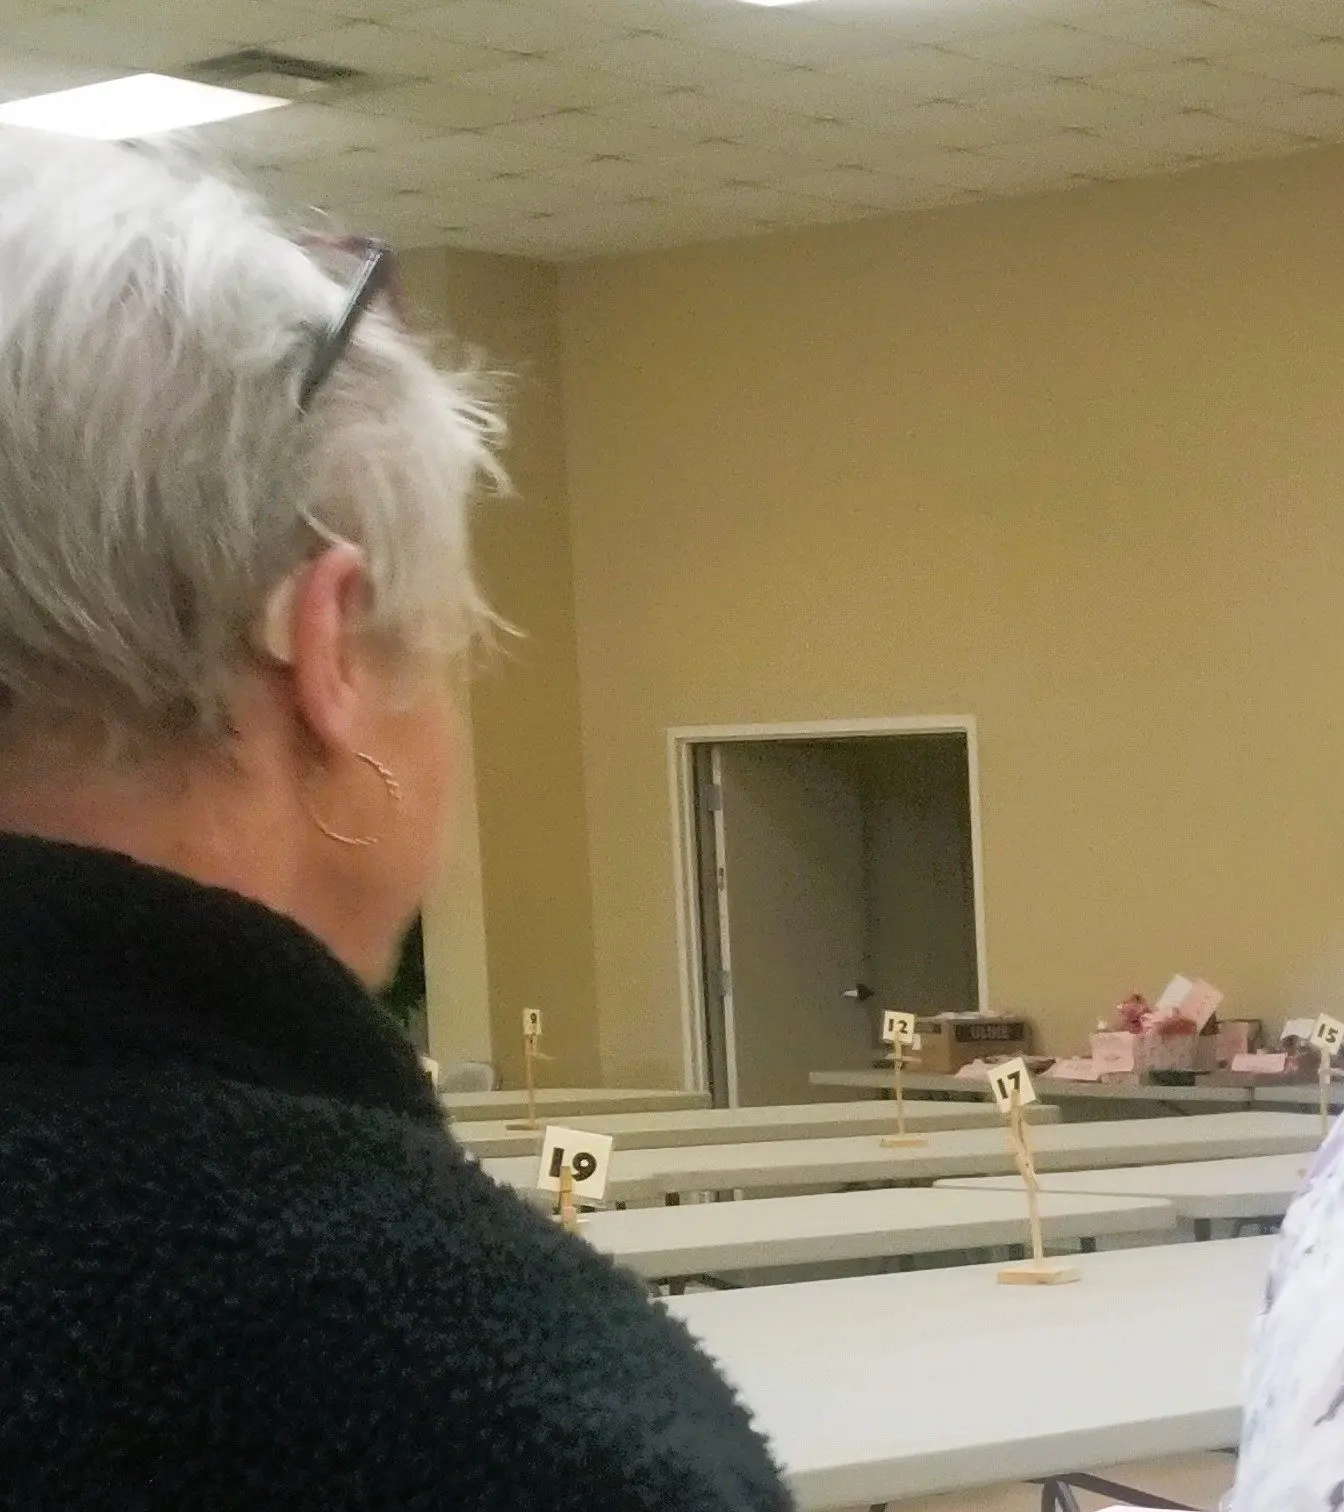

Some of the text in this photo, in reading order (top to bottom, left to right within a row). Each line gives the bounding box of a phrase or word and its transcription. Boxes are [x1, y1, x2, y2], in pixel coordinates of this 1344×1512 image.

[887, 1018, 909, 1035] 12
[1315, 1022, 1339, 1044] 15
[997, 1070, 1021, 1100] 17
[548, 1146, 597, 1182] 19
